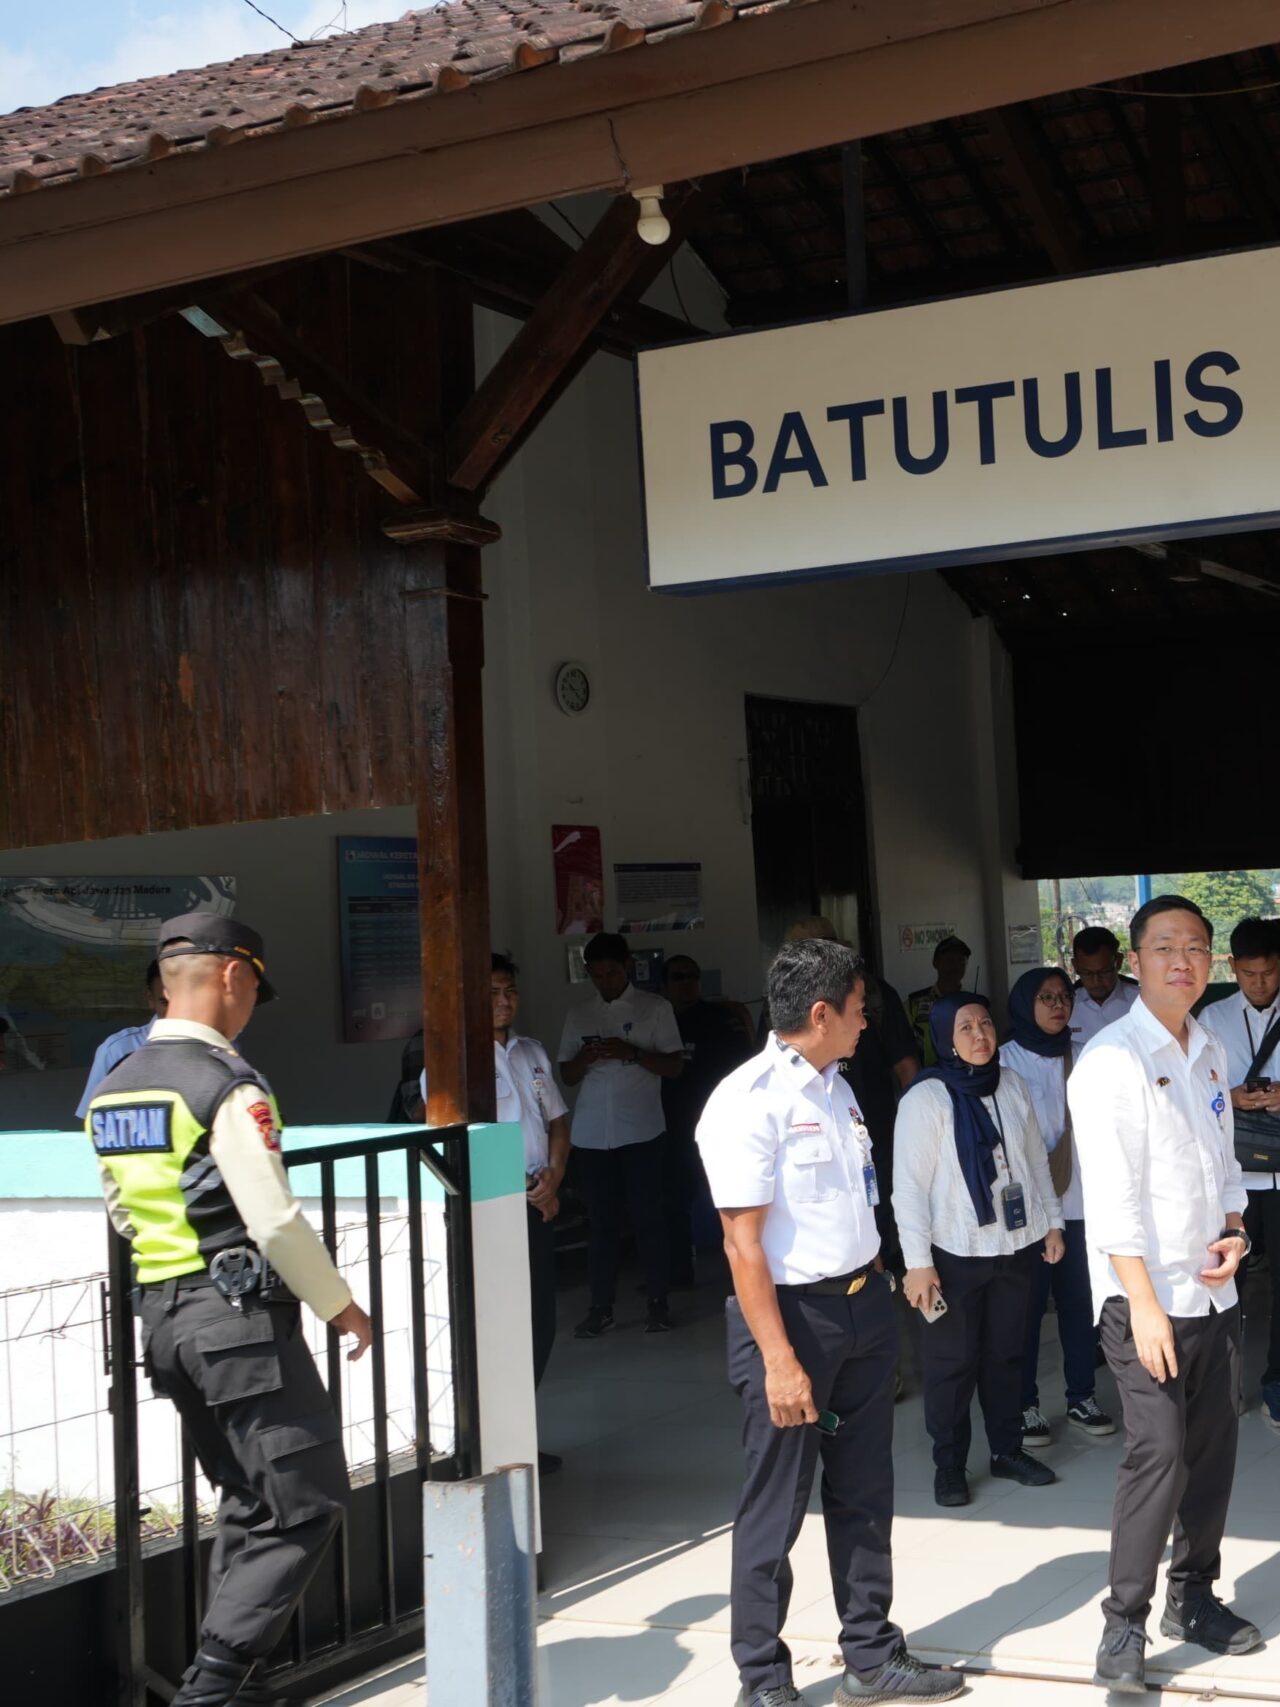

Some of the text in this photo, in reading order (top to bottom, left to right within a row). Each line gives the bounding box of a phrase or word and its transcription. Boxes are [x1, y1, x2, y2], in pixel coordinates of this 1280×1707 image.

[709, 350, 1244, 500] BATUTULIS
[134, 885, 171, 895] Madura
[914, 930, 925, 945] NO
[92, 1108, 166, 1149] SATPAM
